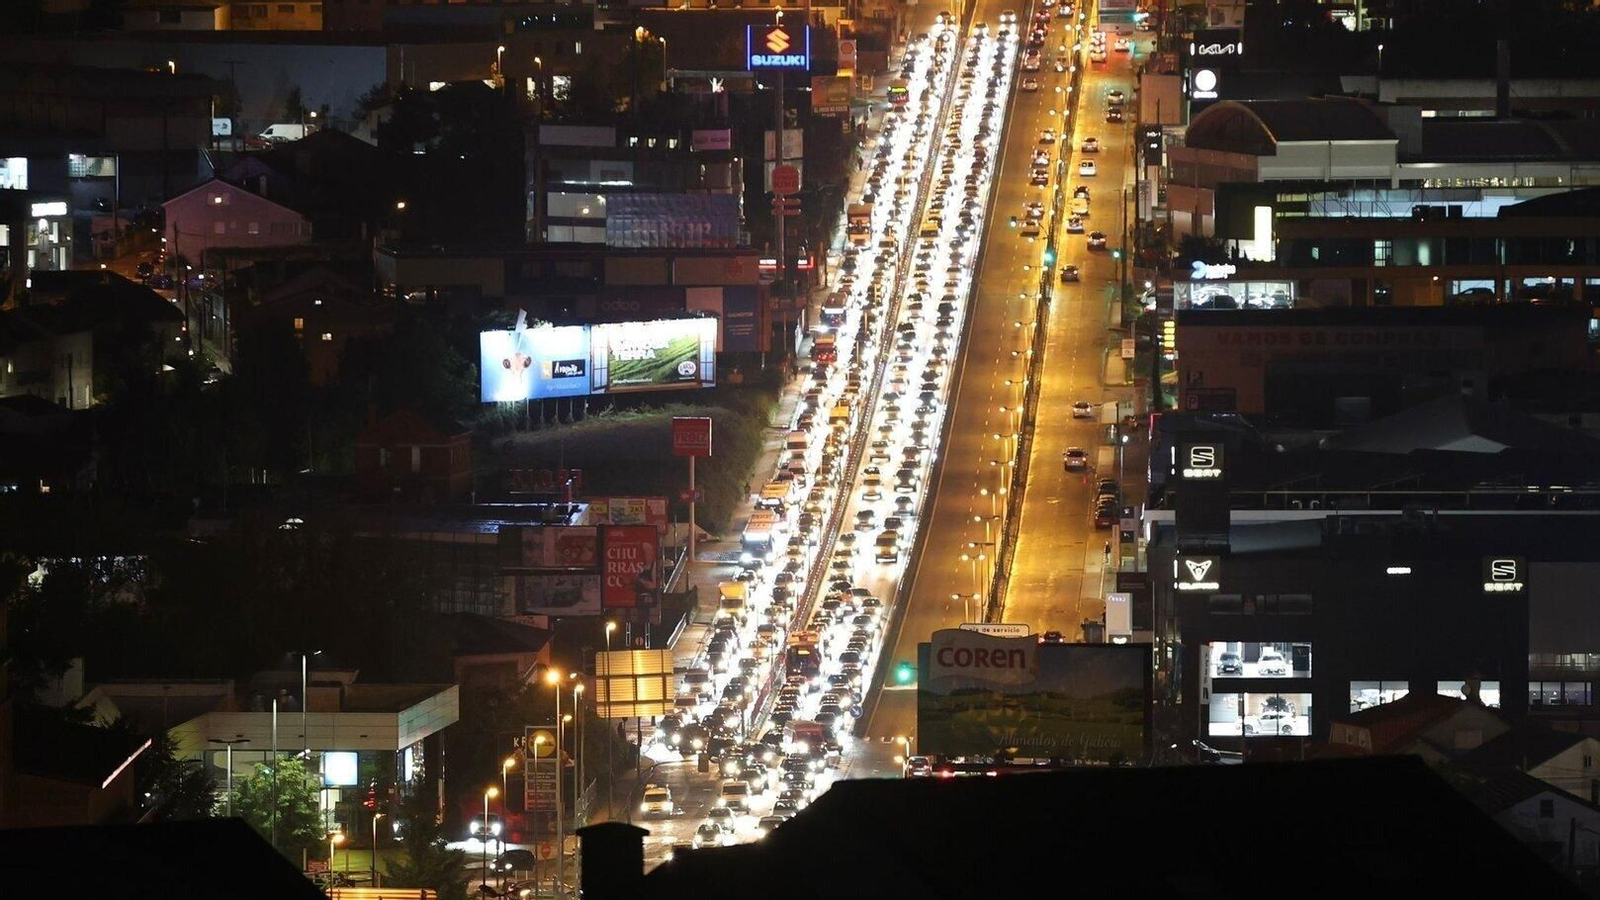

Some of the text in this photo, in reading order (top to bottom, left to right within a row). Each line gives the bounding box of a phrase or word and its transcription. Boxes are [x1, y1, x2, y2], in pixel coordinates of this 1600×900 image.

[751, 54, 805, 66] SUZUKI
[607, 547, 637, 560] CHU
[607, 561, 645, 574] RRAS
[1484, 582, 1523, 592] SEAT
[995, 732, 1055, 747] Alimentos
